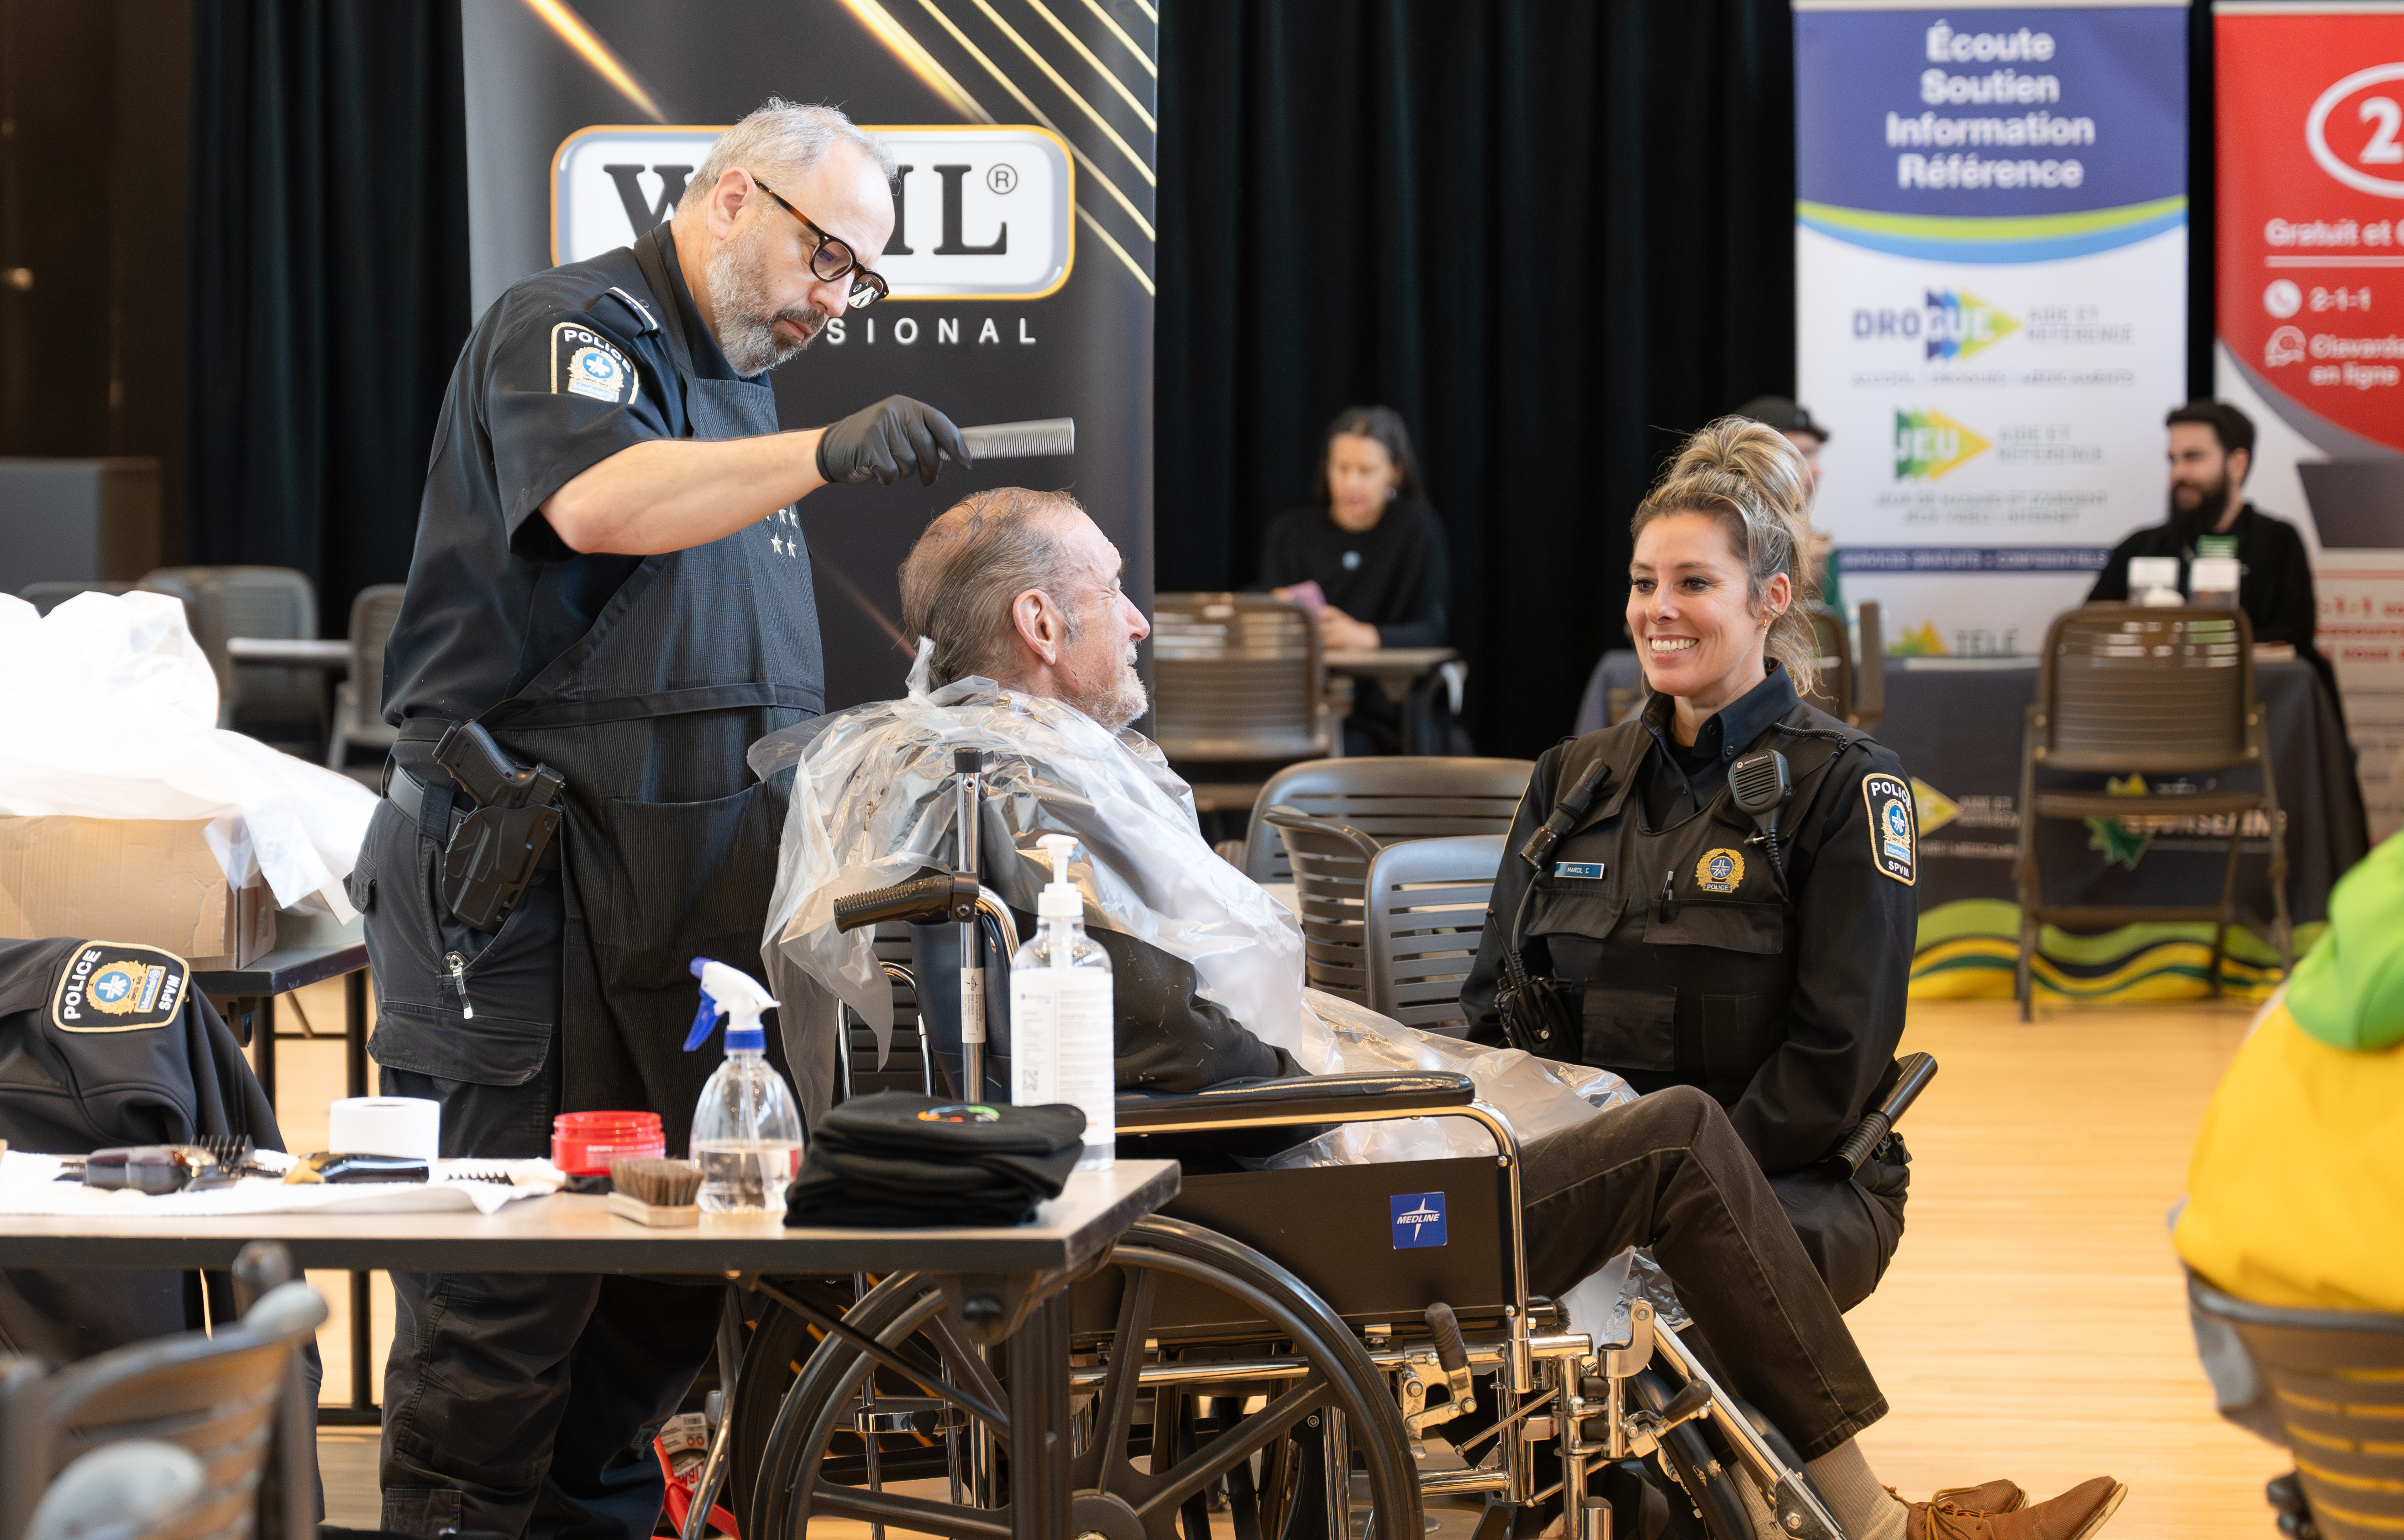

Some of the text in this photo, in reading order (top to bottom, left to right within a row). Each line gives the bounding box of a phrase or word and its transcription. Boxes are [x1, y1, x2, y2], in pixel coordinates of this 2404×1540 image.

[1926, 18, 2056, 63] Écoute
[1921, 68, 2061, 105] Soutien
[1886, 110, 2096, 147] Information
[1897, 152, 2085, 189] Référence
[2264, 218, 2359, 247] Gratuit
[2361, 219, 2392, 247] et
[2309, 286, 2371, 312] 2-1-1
[1896, 427, 1958, 460] JEU
[1870, 781, 1910, 812] POLICE
[1888, 860, 1909, 878] SPVM
[64, 950, 102, 1020] POLICE
[158, 974, 180, 1011] SPVM
[1397, 1214, 1440, 1224] MEDLINE
